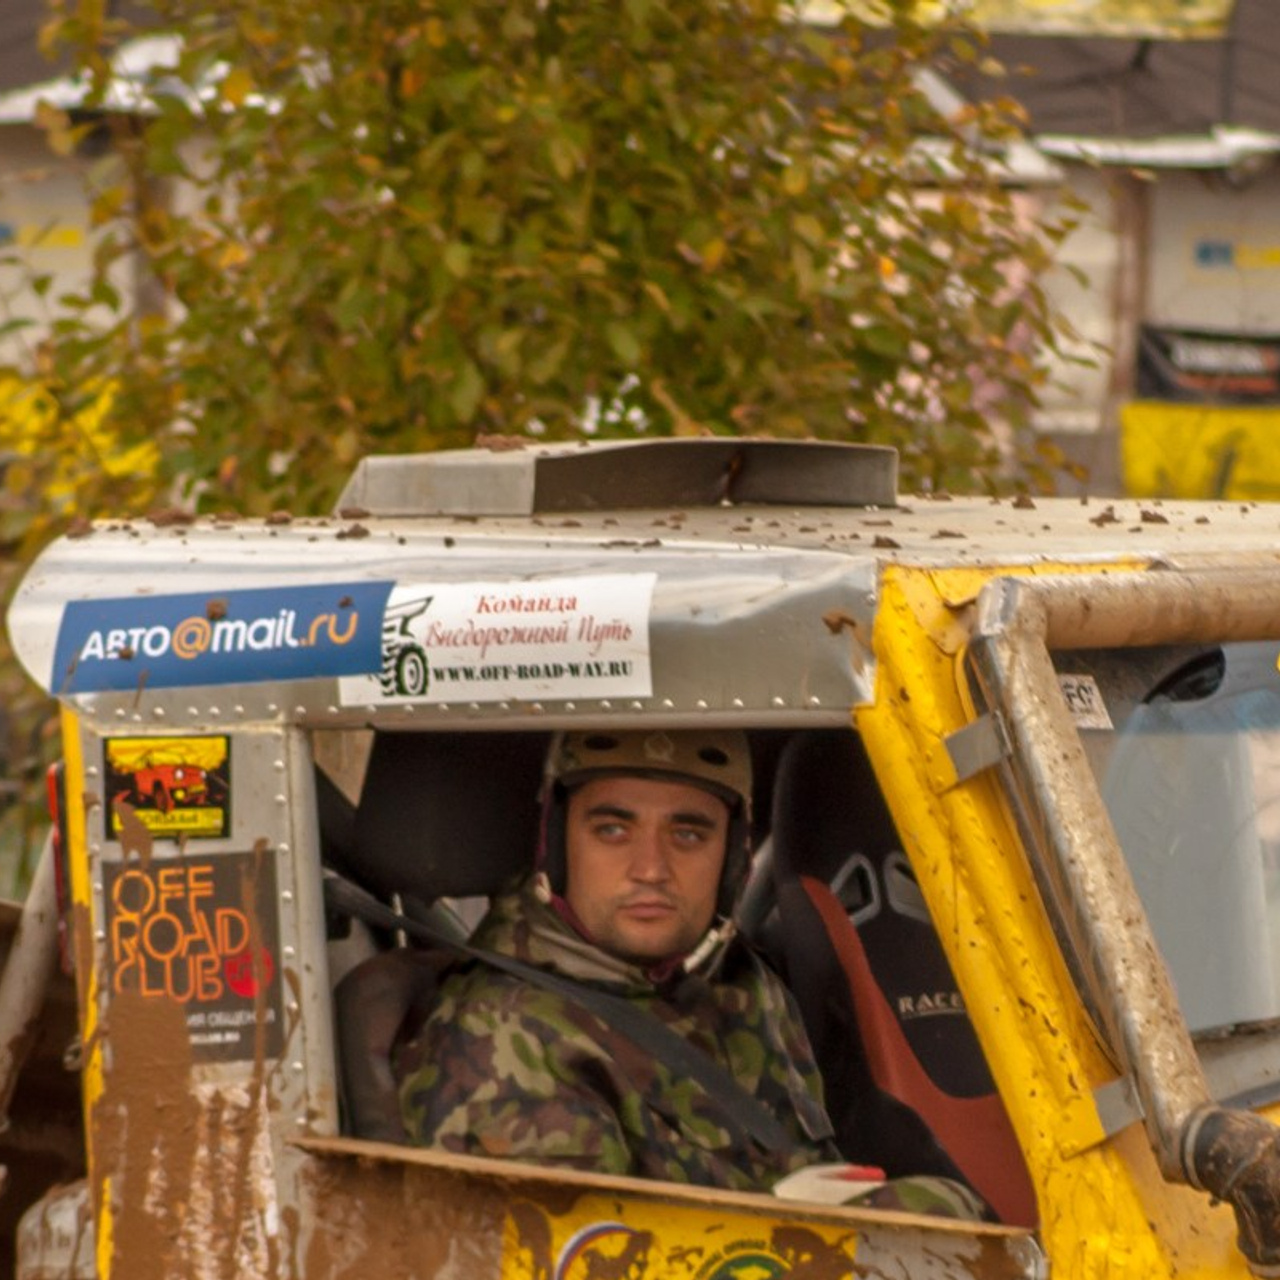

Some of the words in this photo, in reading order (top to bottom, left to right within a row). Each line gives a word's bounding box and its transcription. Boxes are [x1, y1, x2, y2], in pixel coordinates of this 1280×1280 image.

[476, 594, 578, 614] Команда
[433, 660, 634, 682] WWW.OFF-ROAD-WAY.RU
[112, 866, 214, 914] OFF
[112, 908, 251, 962] ROAD
[113, 953, 224, 1001] CLUB
